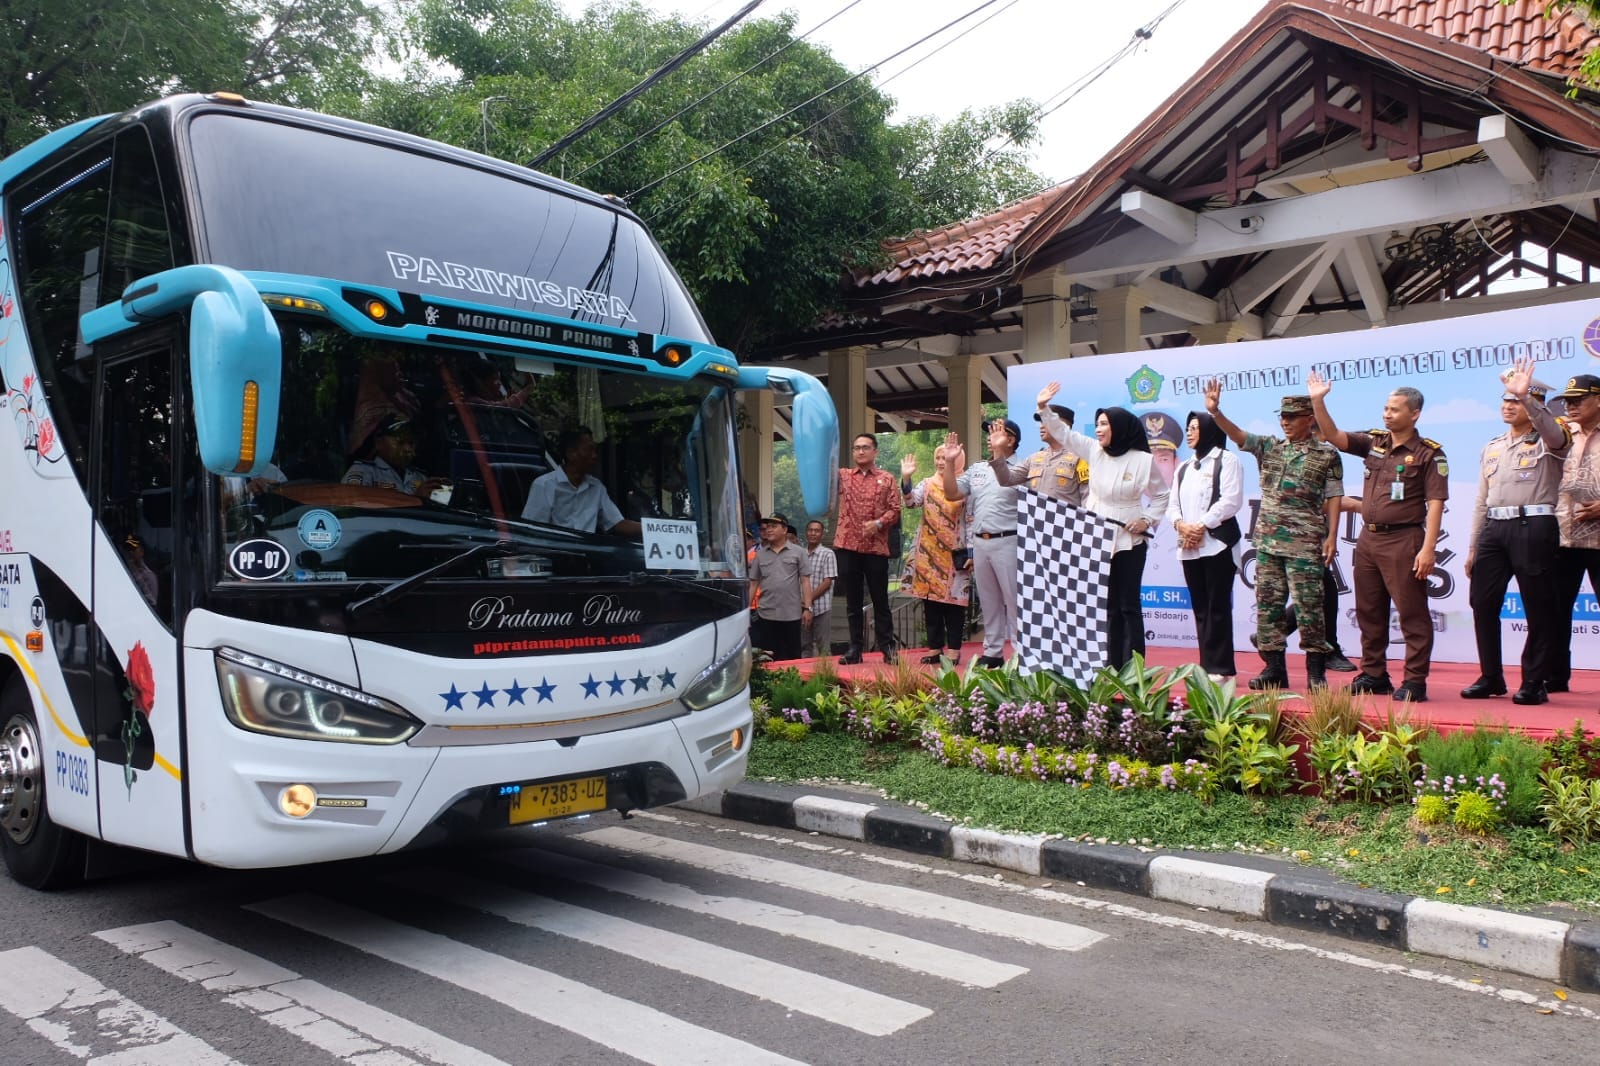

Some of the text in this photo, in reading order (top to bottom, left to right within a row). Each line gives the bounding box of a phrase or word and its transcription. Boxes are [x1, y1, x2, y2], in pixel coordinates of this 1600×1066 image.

[386, 251, 637, 323] PARIWISATA
[562, 329, 613, 349] PRIMA
[1311, 350, 1446, 383] KABUPATEN
[1452, 336, 1576, 370] SIDOARJO
[315, 519, 327, 530] A
[646, 523, 693, 534] MAGETAN
[649, 542, 663, 559] A
[675, 543, 694, 561] 01
[1162, 590, 1188, 605] SH.,
[468, 595, 642, 630] Pratama Putra
[1154, 610, 1189, 622] Sidoarjo
[473, 633, 642, 655] ptpratamaputra.com
[56, 750, 89, 797] PP 0383
[540, 782, 577, 806] 7383
[586, 778, 604, 799] UZ
